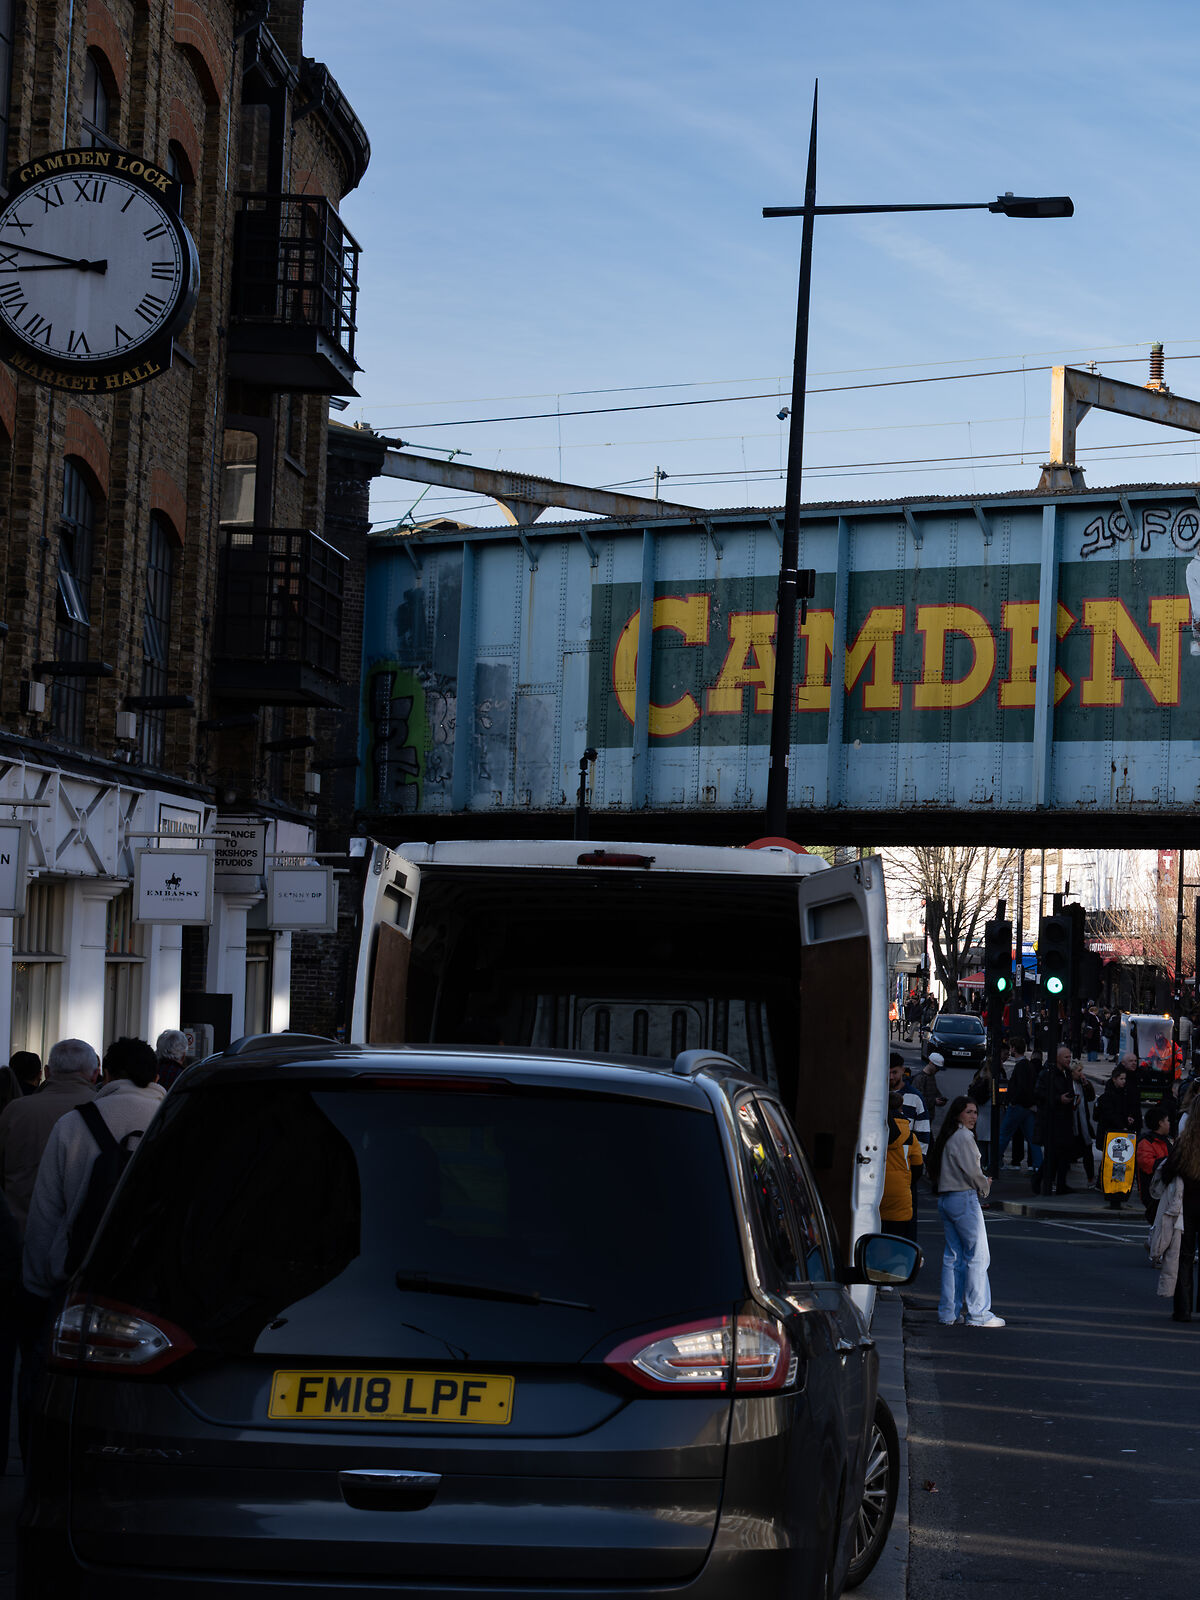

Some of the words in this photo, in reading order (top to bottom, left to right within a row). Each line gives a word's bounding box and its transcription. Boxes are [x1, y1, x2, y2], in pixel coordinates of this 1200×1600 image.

[20, 151, 111, 183] CAMDEN
[115, 155, 173, 193] LOCK
[8, 351, 99, 391] MARKET
[104, 360, 161, 389] HALL
[612, 592, 1191, 738] CAMDEN
[215, 849, 258, 858] RKSHOPS
[224, 839, 237, 847] TO
[215, 858, 253, 867] STUDIOS
[146, 889, 200, 897] EMBASSY
[295, 1376, 391, 1413] FM18
[402, 1378, 488, 1417] LPF
